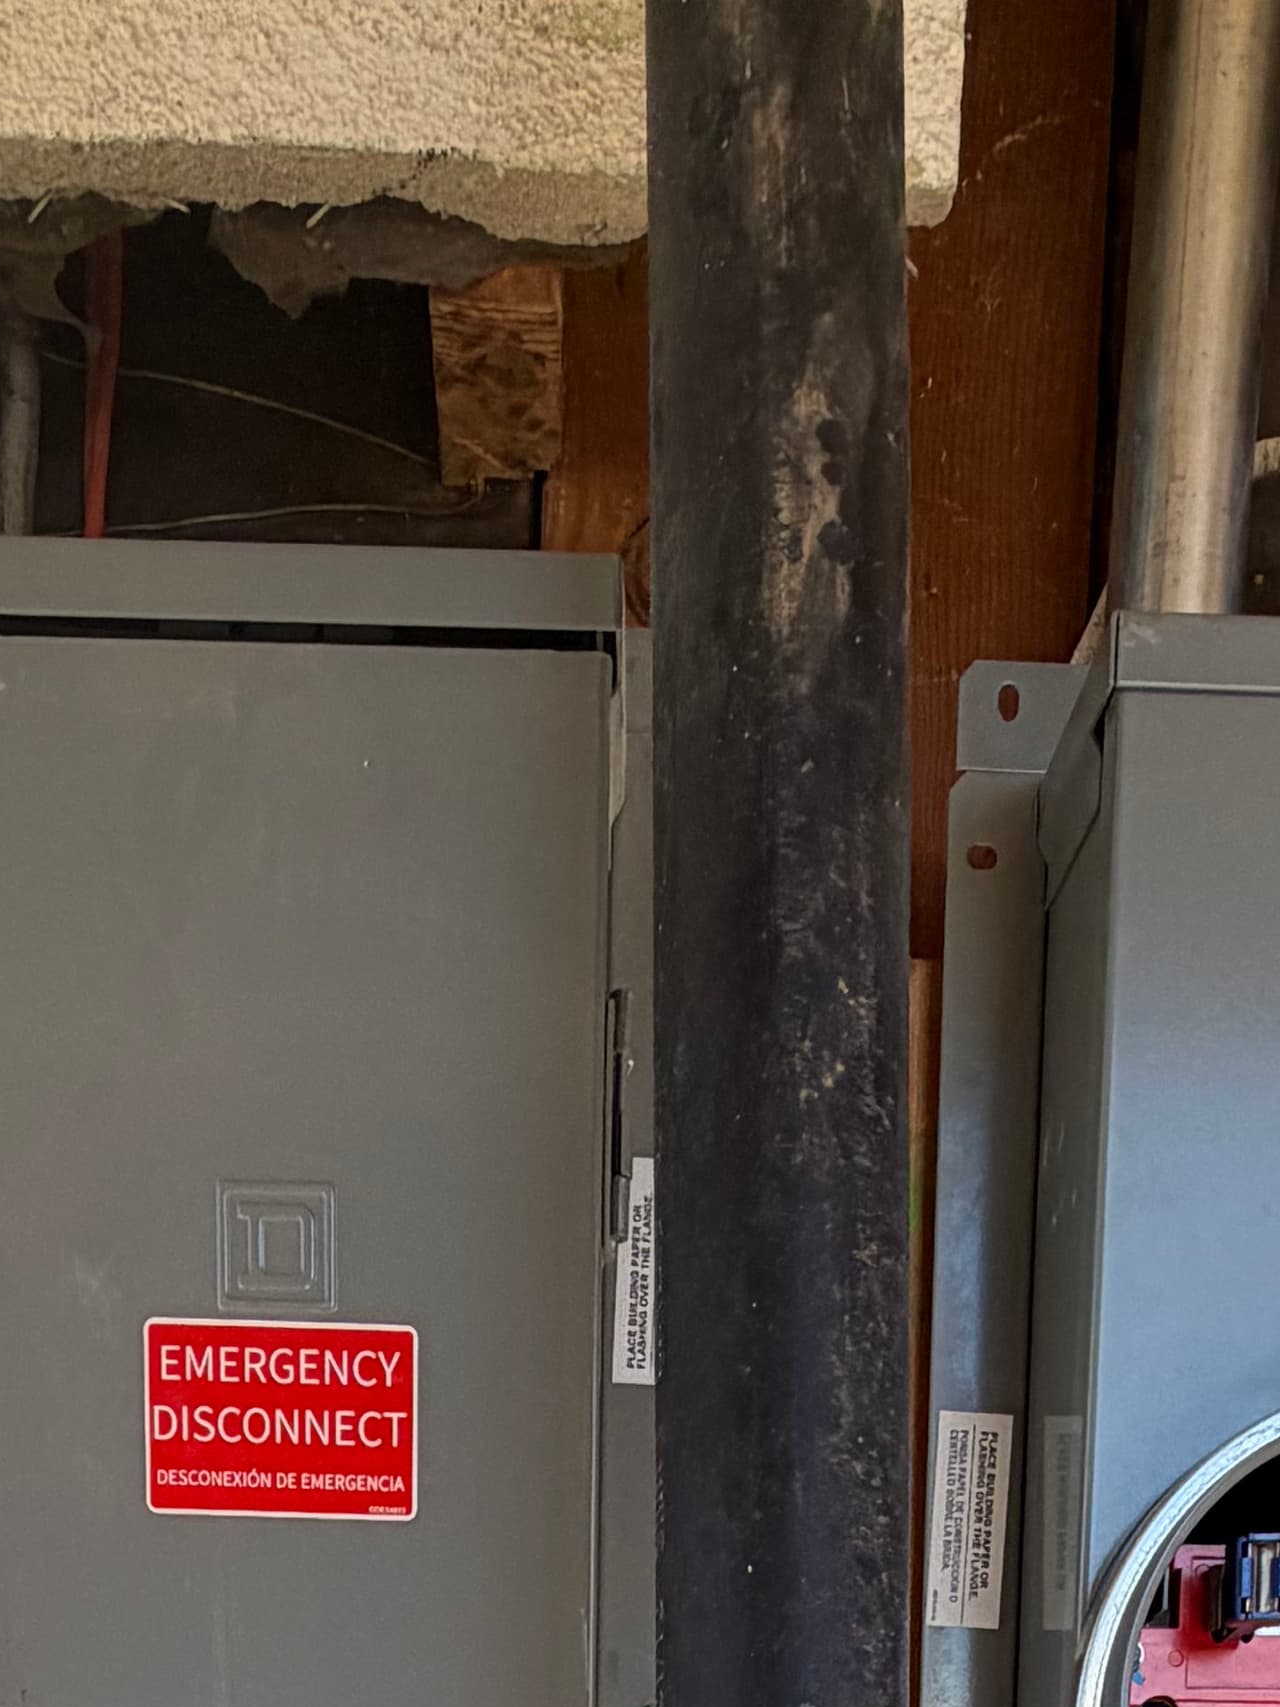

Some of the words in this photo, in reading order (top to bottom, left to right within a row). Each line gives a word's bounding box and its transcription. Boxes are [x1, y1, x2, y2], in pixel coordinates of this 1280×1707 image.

[632, 1204, 642, 1223] OR
[630, 1226, 642, 1268] PAPER
[640, 1246, 651, 1269] THE
[627, 1271, 640, 1327] BUILDING
[639, 1273, 649, 1307] OVER
[625, 1329, 637, 1370] PLACE
[636, 1311, 648, 1370] FLASHING
[159, 1344, 402, 1388] EMERGENCY
[152, 1405, 408, 1449] DISCONNECT
[976, 1430, 989, 1489] FLASHING
[987, 1431, 1000, 1470] PLACE
[156, 1469, 273, 1490] DESCONEXIÓN
[276, 1473, 297, 1490] DE
[301, 1473, 406, 1493] EMERGENCIA
[983, 1473, 997, 1528] BUILDING
[974, 1491, 985, 1525] OVER
[971, 1527, 982, 1550] THE
[980, 1530, 993, 1569] PAPER
[979, 1571, 990, 1590] OR
